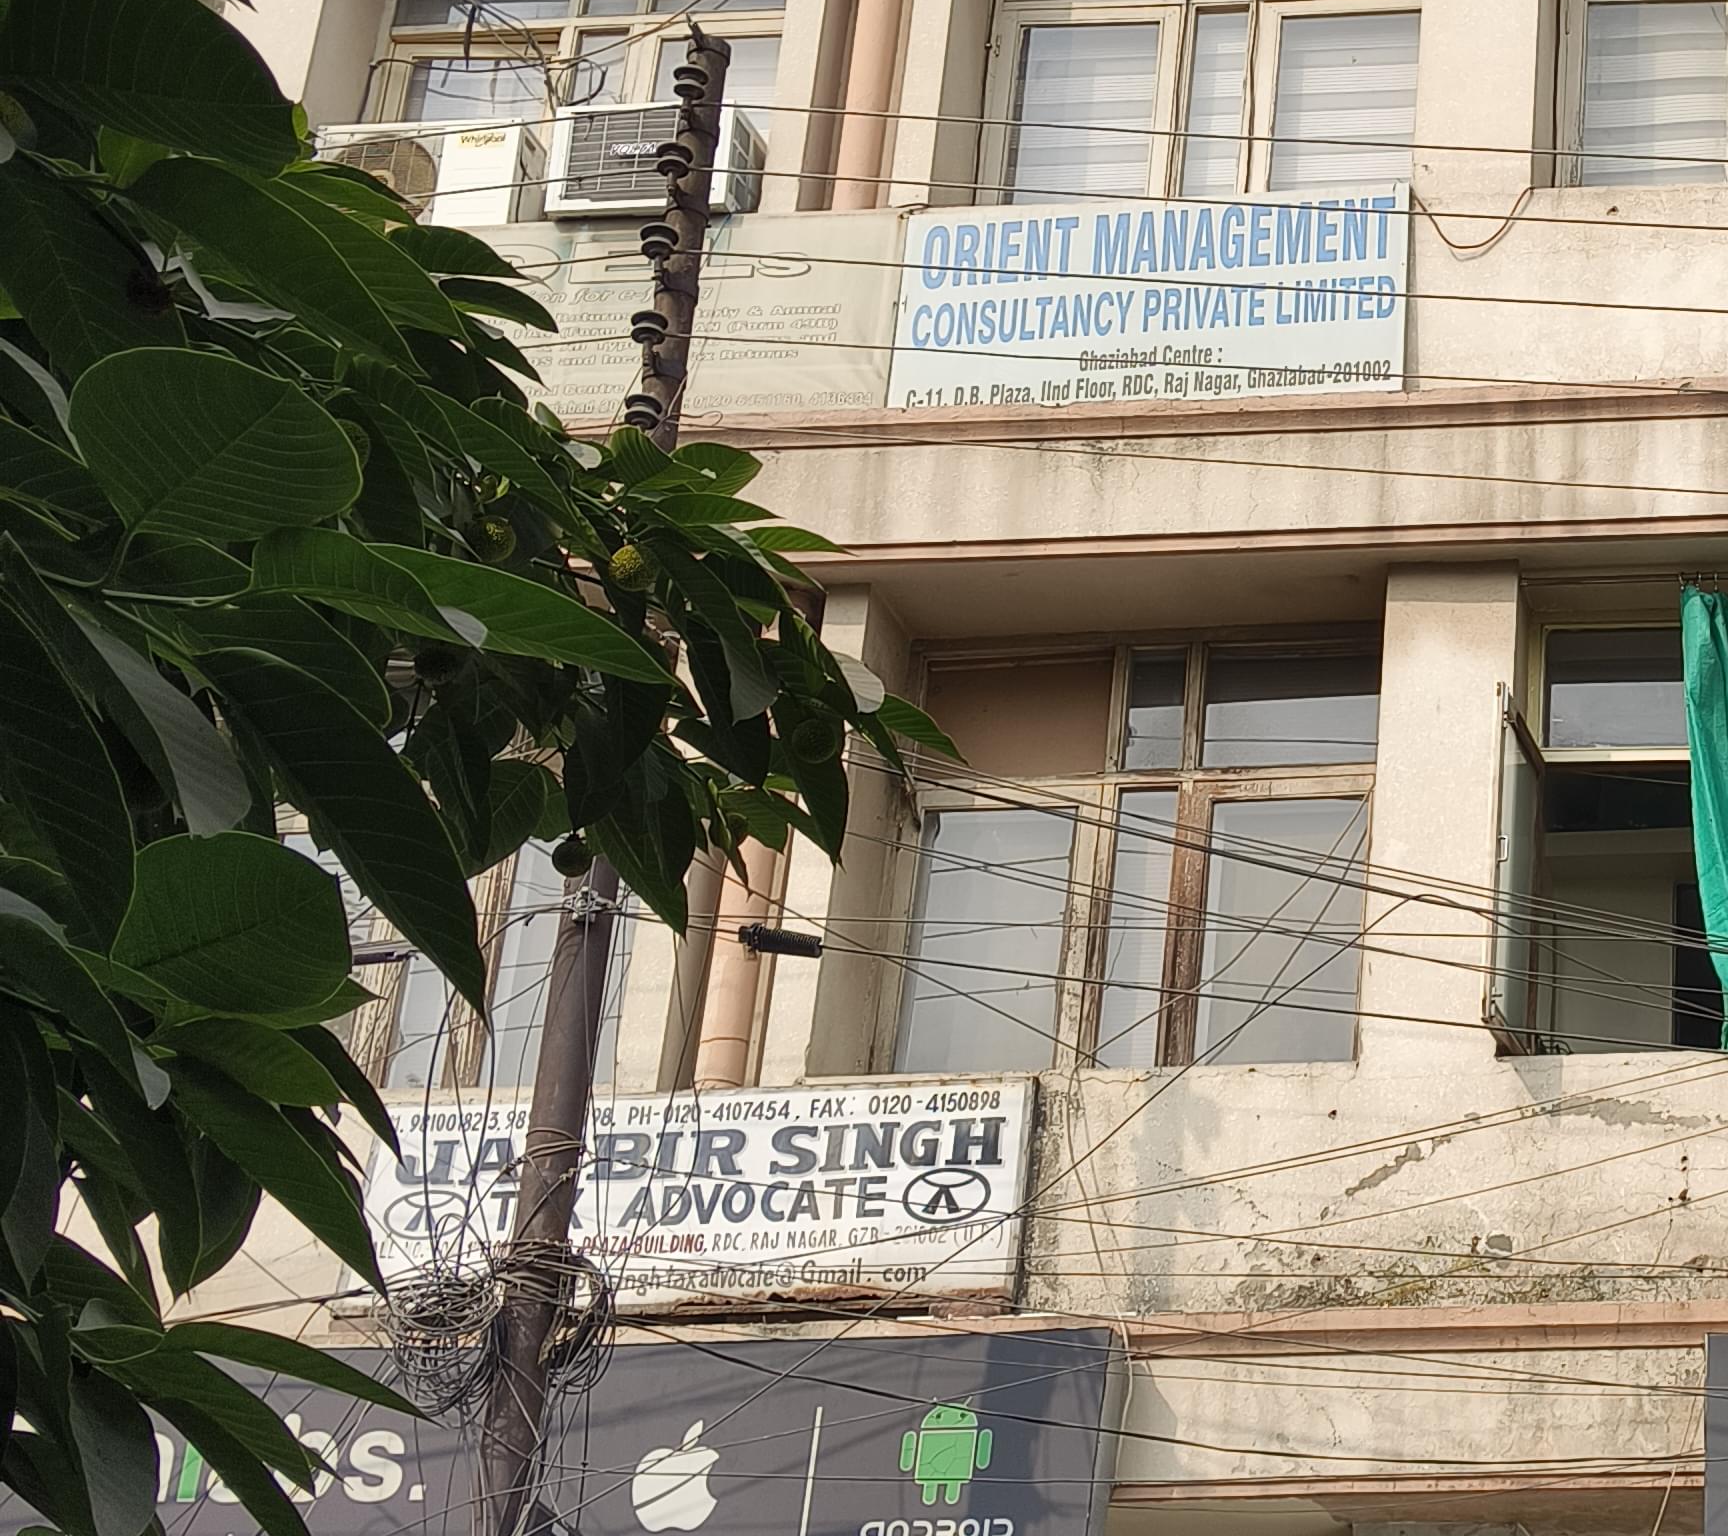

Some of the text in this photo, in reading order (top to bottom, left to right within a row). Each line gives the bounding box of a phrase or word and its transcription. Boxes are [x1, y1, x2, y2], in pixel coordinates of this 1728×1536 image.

[610, 143, 657, 157] VOLTA
[921, 196, 1396, 289] ORIENT MANAGEMENT
[912, 274, 1395, 347] CONSULTANCY PRIVATE LIMITED
[1080, 345, 1214, 372] Ghaziabad Centre
[1076, 370, 1242, 401] Floor, RDC, Raj Nagar,
[395, 1117, 1007, 1186] JABIR SINGH
[617, 1175, 888, 1228] ADVOCATE
[750, 1231, 779, 1251] RAJ
